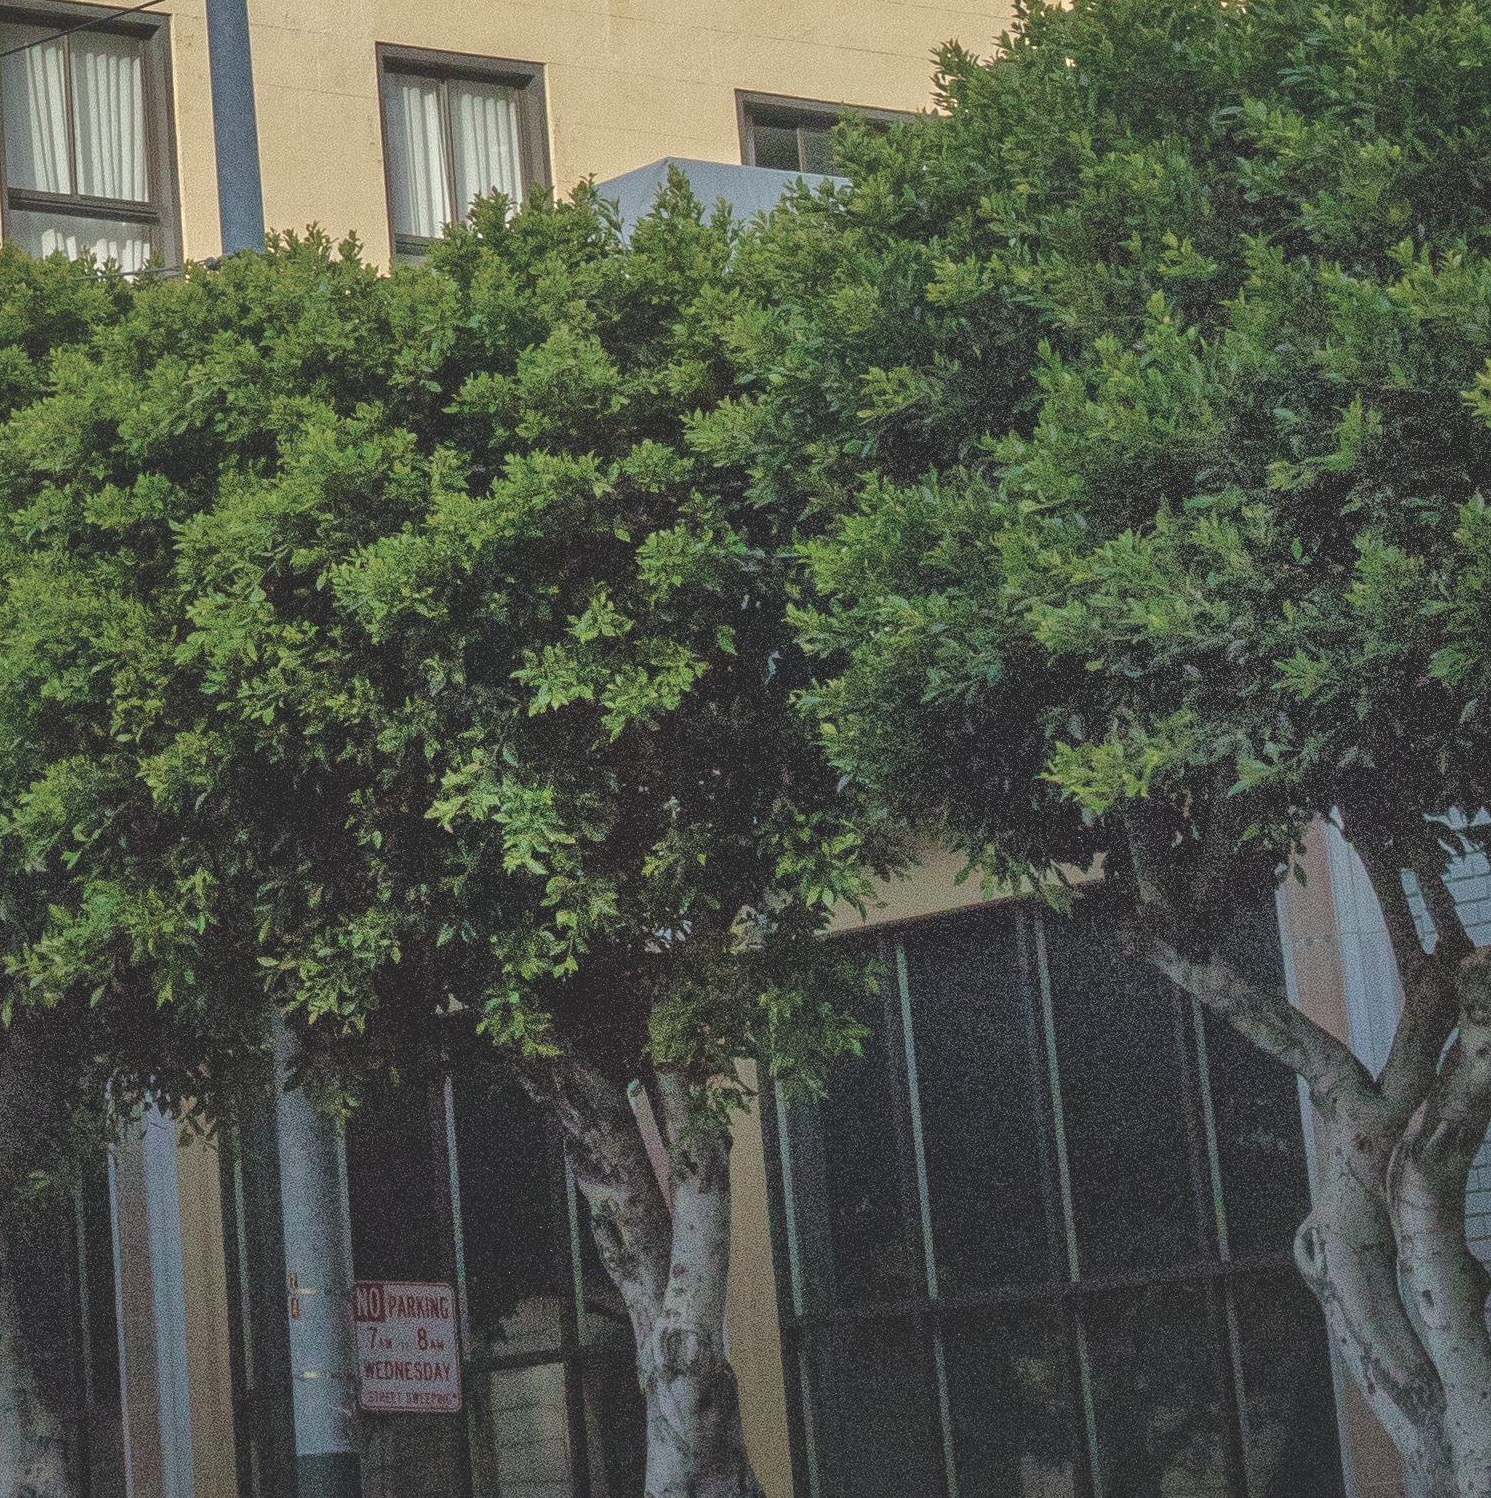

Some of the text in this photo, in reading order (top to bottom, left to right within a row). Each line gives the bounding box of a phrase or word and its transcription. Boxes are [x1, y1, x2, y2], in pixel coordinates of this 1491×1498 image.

[356, 1286, 449, 1319] NO PARKING
[364, 1361, 451, 1381] WEDNESDAY
